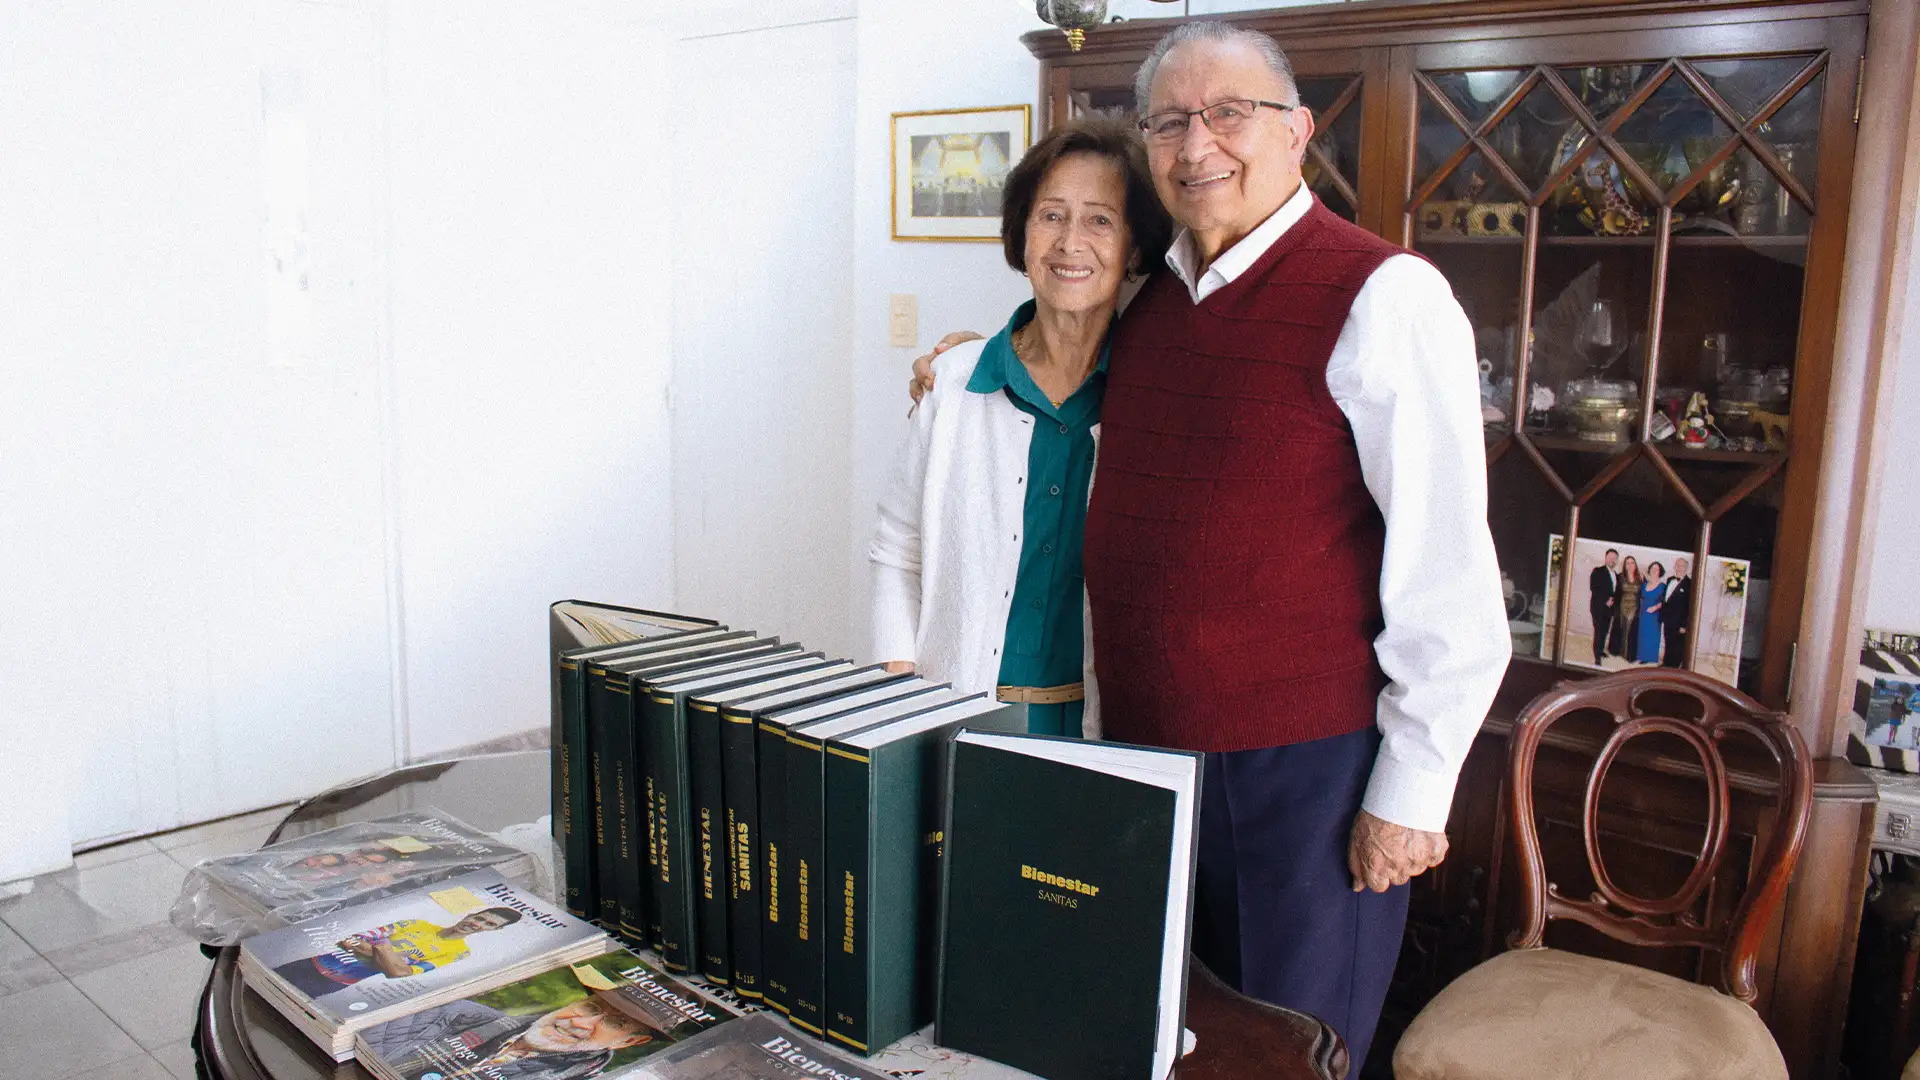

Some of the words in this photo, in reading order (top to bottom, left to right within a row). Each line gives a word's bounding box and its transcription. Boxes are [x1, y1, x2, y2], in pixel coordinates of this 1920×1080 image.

[595, 805, 604, 845] REVISTA
[658, 791, 670, 882] BIENESTAR
[728, 807, 736, 859] BIENESTAR
[701, 807, 713, 899] BIENESTAR
[737, 822, 751, 891] SANITAS
[485, 883, 568, 930] Bienestar
[769, 842, 778, 923] Bienestar
[799, 859, 809, 941] Bienestar
[1021, 865, 1100, 897] Bienestar
[1038, 889, 1078, 909] SANITAS
[843, 870, 855, 954] Bienestar
[619, 965, 716, 1023] Bienestar
[624, 984, 679, 1020] OLSANITAS
[443, 1036, 478, 1060] Jorge
